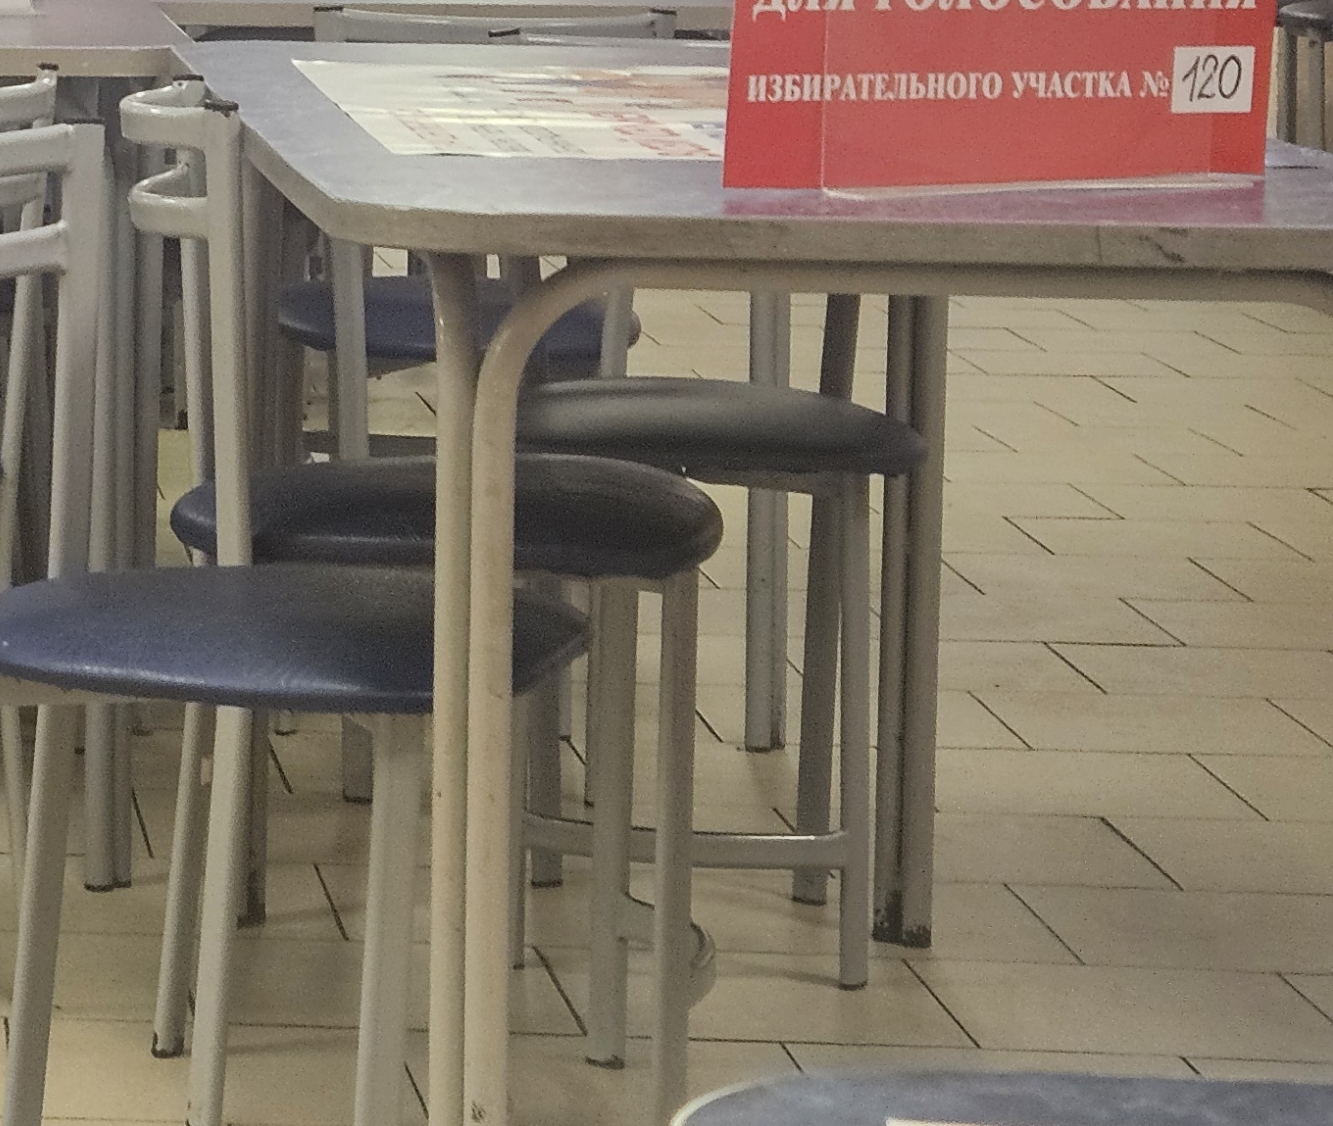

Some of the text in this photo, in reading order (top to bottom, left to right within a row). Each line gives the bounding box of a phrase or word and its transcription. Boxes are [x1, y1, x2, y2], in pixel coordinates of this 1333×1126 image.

[746, 53, 1243, 104] ИЗБИРАТЕЛЬНОГО УЧАСТКА № 120
